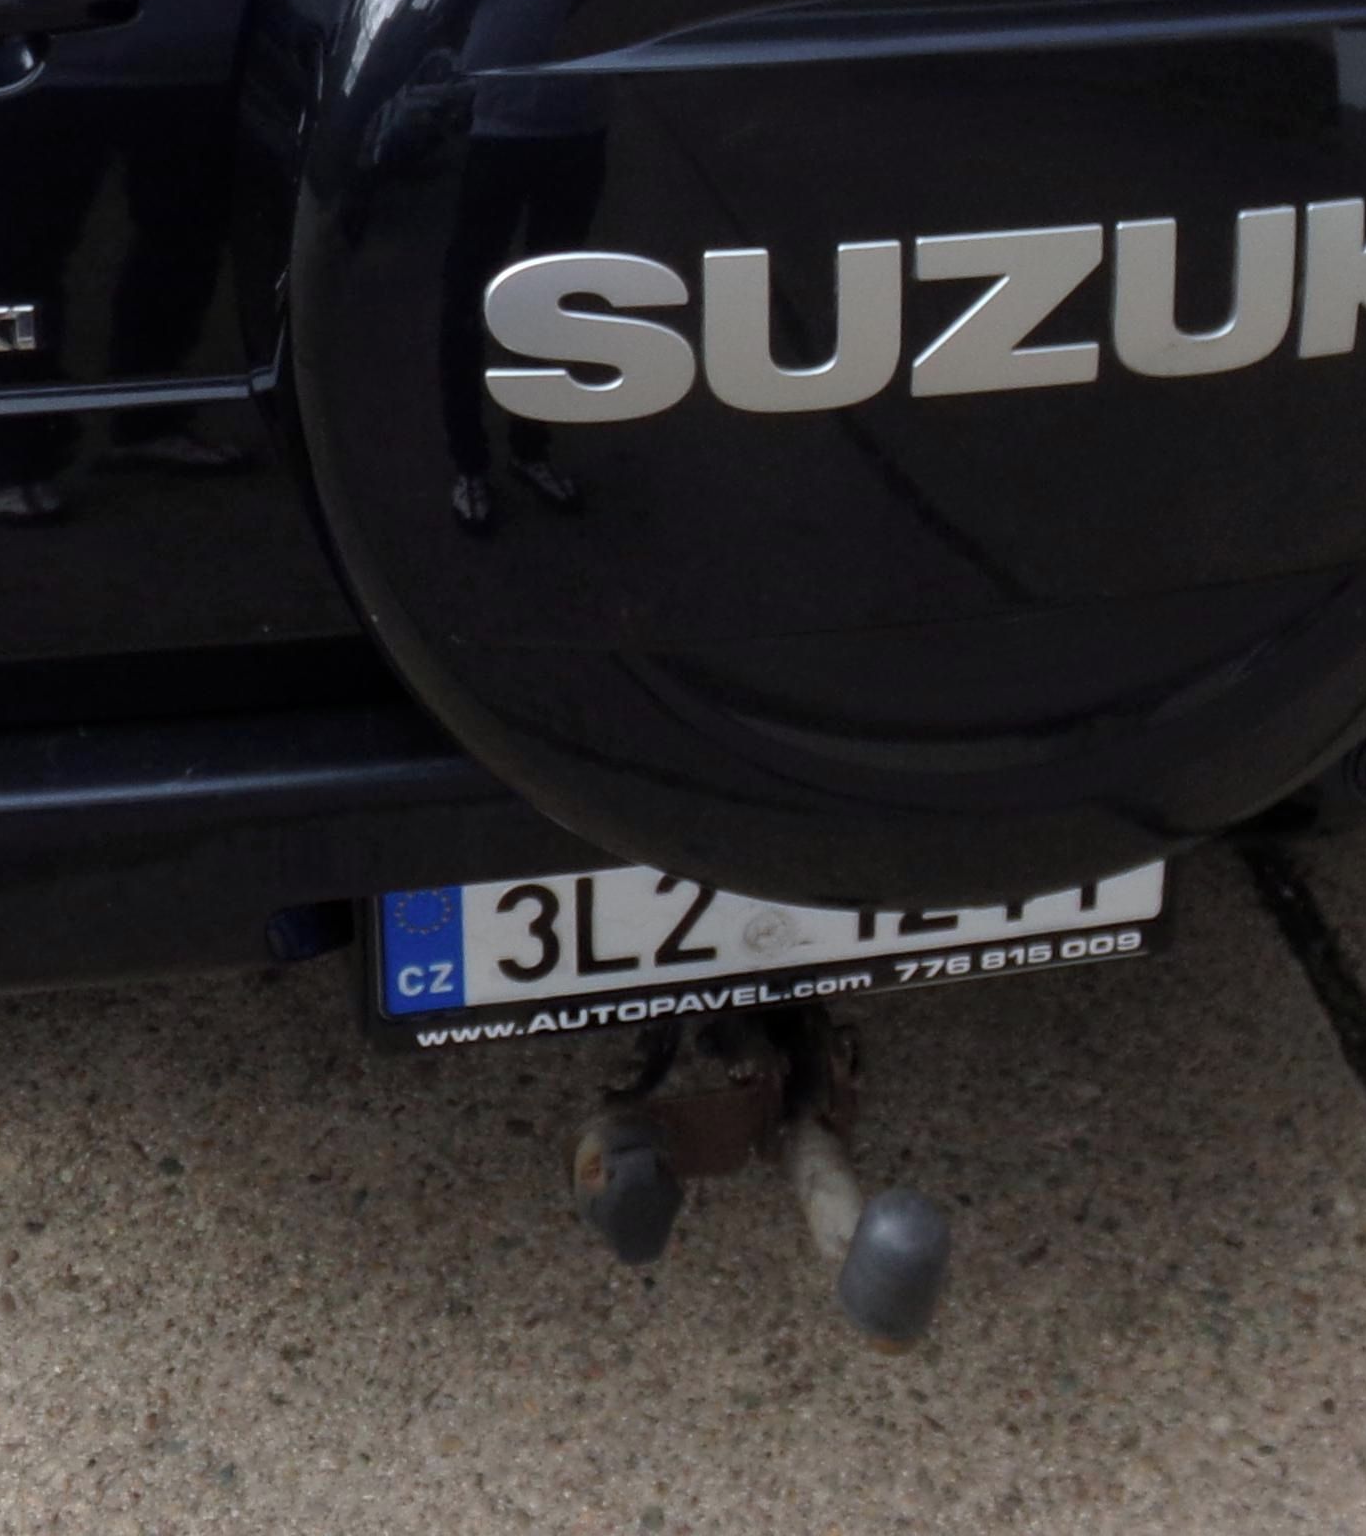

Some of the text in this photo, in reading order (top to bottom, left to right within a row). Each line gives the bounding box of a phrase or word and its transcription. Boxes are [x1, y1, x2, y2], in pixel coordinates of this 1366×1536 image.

[397, 963, 453, 997] CZ
[496, 876, 718, 983] 3L2
[416, 930, 1142, 1047] www.AUTOPAVEL.com 776 815 009
